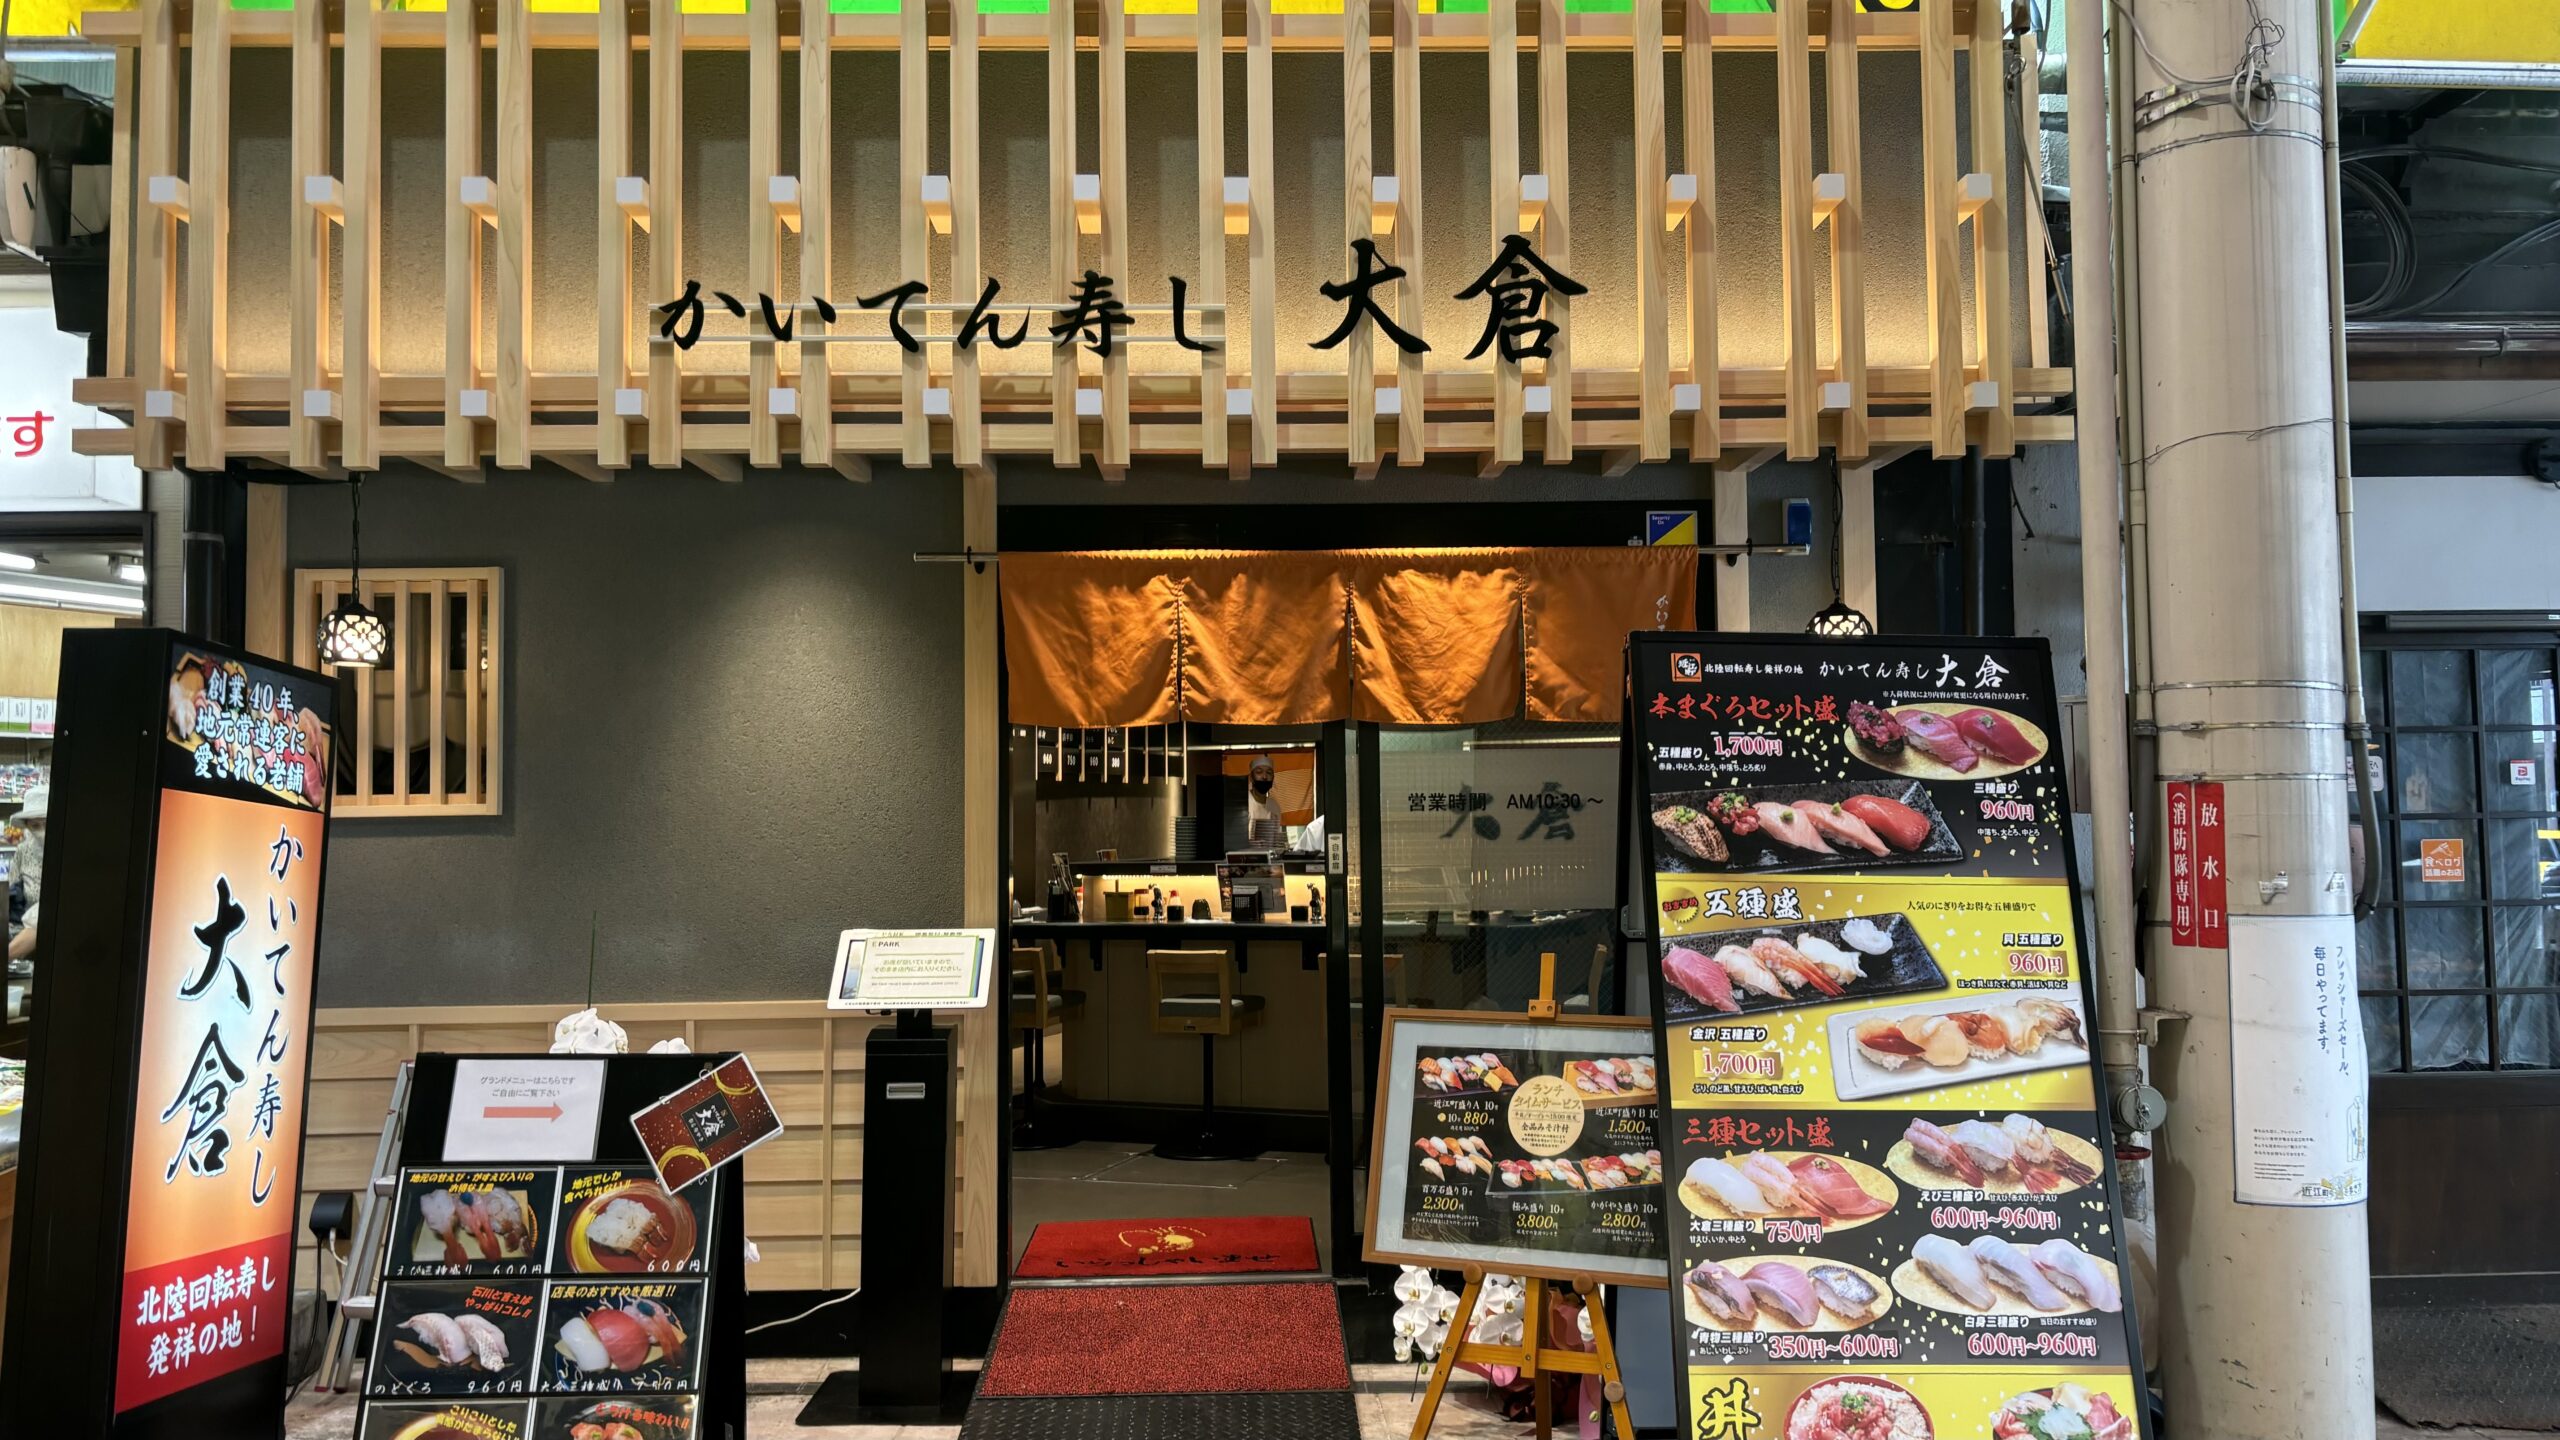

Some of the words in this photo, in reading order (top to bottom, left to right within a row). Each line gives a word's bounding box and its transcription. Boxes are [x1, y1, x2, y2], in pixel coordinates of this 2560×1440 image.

[658, 273, 1221, 359] かいてん寿し
[1307, 234, 1589, 364] 大倉
[1704, 663, 1804, 676] 北陸回転寿し発祥の地
[1819, 660, 1930, 680] かいてん寿し
[1935, 653, 2010, 689] 大倉
[1649, 691, 1840, 722] 本まぐろセット盛
[195, 705, 306, 757] 地元常連客に
[1658, 746, 1704, 759] 五種盛り
[1713, 735, 1783, 758] 1,700円
[194, 742, 305, 795] 愛される老舗
[1973, 782, 2018, 794] 三種盛り
[1407, 792, 1487, 811] 営業時間
[1980, 799, 2035, 821] 960円
[2200, 802, 2219, 928] 放水口
[2424, 856, 2462, 867] 食べログ
[1703, 886, 1803, 920] 五種盛
[1906, 900, 2037, 912] 人気のにぎりをお得な五種盛りで
[2018, 933, 2064, 947] 五種盛り
[2009, 952, 2064, 975] 960円
[2313, 945, 2330, 1055] 毎日やってます。
[246, 824, 304, 1207] かいてん寿し
[160, 873, 253, 1184] 大倉
[1691, 1027, 1717, 1042] 金沢
[1719, 1027, 1768, 1042] 五種盛り
[1702, 1052, 1775, 1077] 1,700円
[480, 1075, 576, 1086] グランドメニューはこちらです
[1532, 1083, 1565, 1097] ランチ
[491, 1088, 560, 1098] ご自由にご覧下さい
[1513, 1095, 1581, 1110] タイムサービス
[1682, 1115, 1835, 1147] 三種セット盛
[1919, 1189, 1984, 1202] えび三種盛り
[1689, 1219, 1755, 1233] 大倉三種盛り
[1764, 1219, 1822, 1244] 750円
[647, 1258, 701, 1273] 600円
[136, 1255, 277, 1326] 北陸回転寿し
[1964, 1315, 2030, 1328] 白身三種盛り
[374, 1380, 432, 1395] のどぐろ
[467, 1380, 523, 1393] 960円
